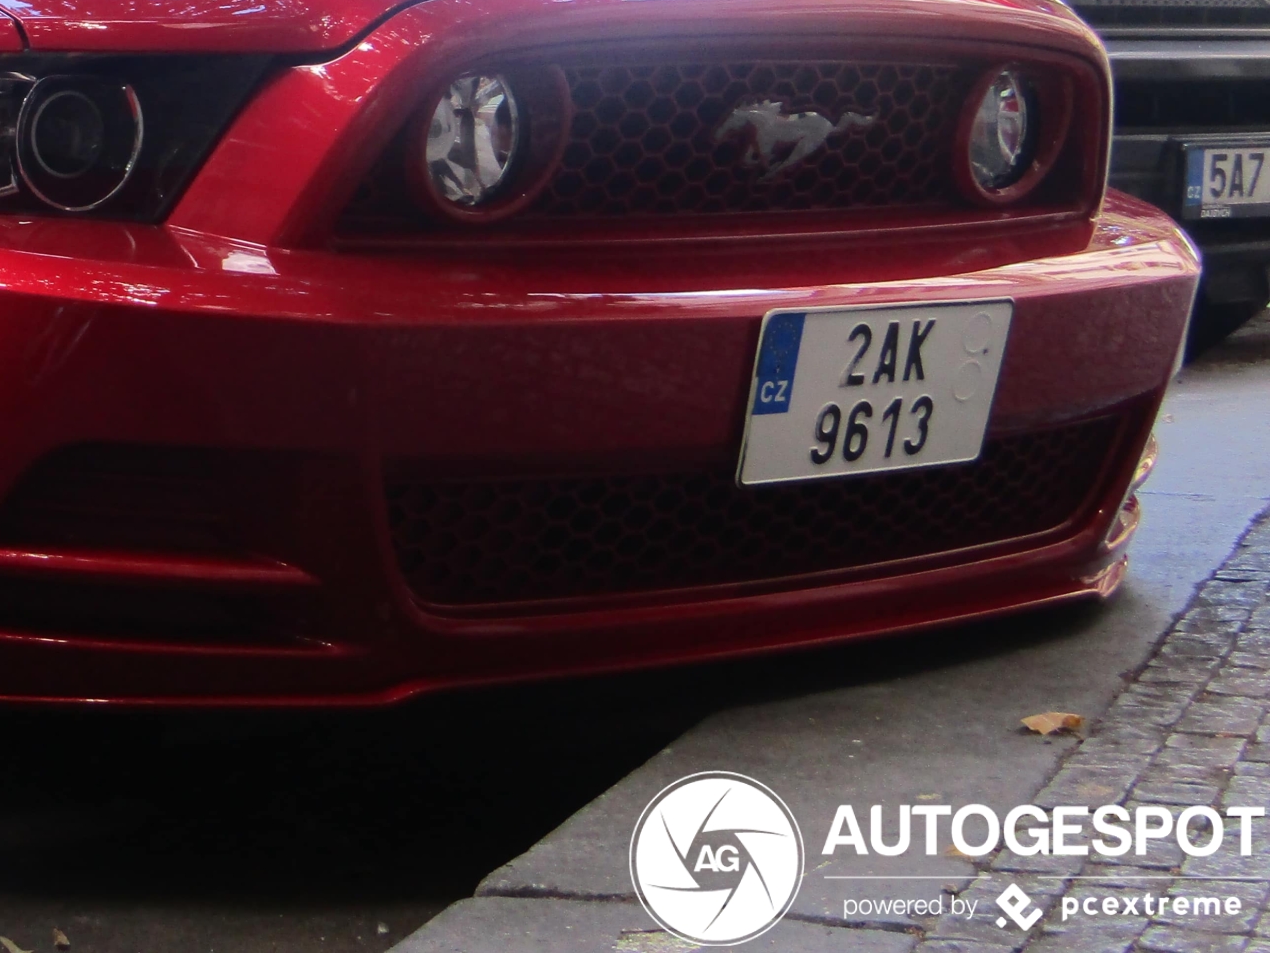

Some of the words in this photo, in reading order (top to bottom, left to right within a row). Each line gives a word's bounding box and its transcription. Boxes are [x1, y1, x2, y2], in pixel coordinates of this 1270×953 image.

[1187, 186, 1201, 199] CZ
[1210, 152, 1265, 198] 5A7
[839, 317, 937, 388] 2AK
[761, 380, 788, 403] CZ
[809, 393, 934, 465] 9613
